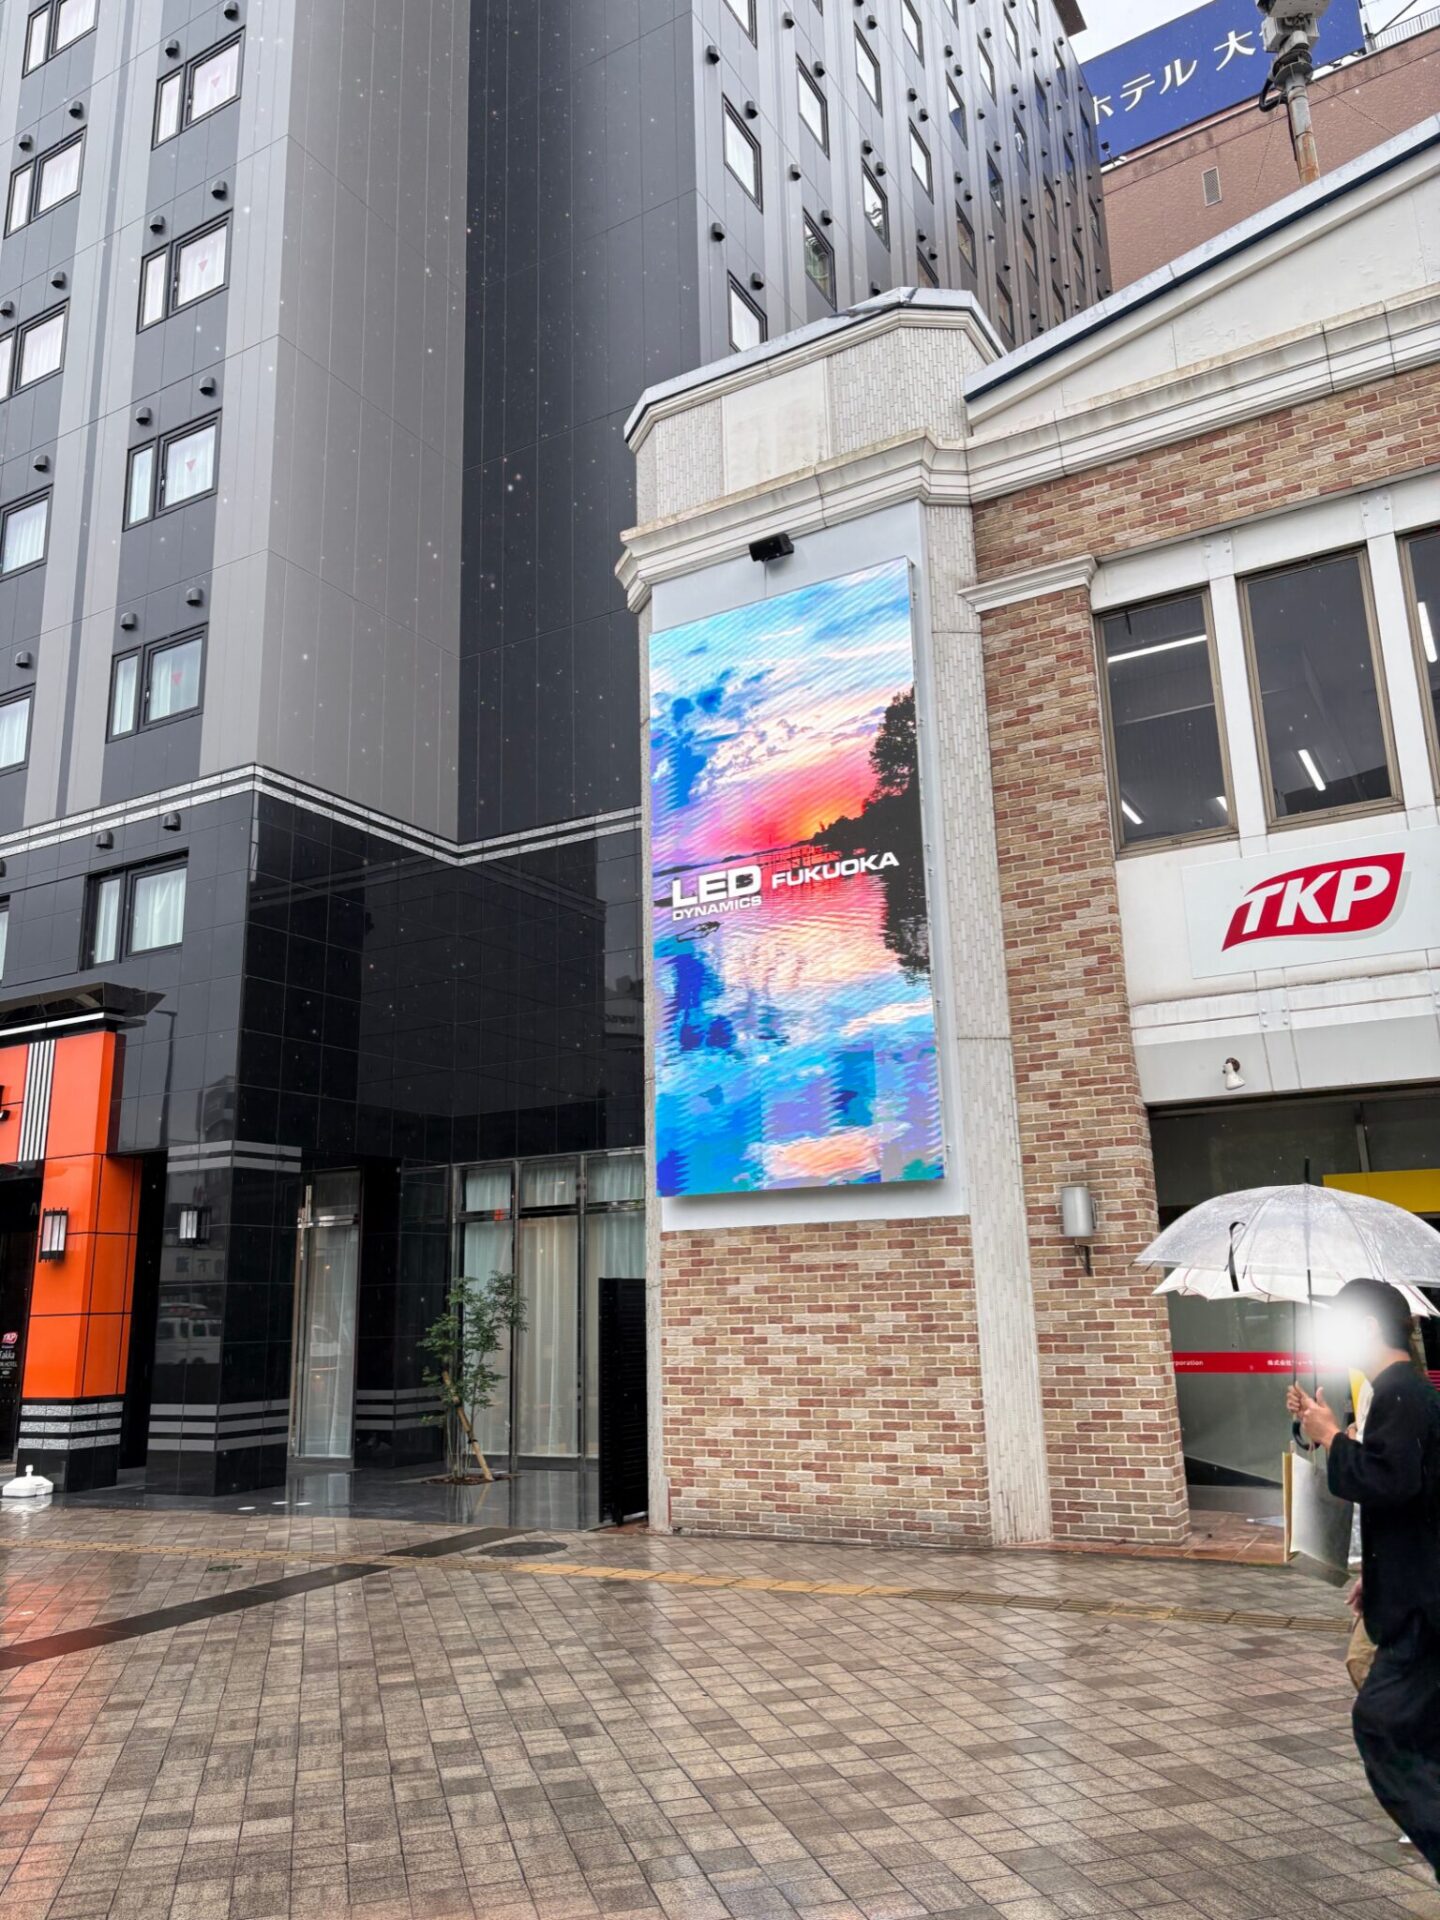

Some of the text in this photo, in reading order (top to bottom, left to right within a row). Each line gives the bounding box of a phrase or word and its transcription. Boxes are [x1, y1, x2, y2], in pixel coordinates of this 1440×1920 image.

[671, 851, 900, 908] LED FUKUOKA
[672, 895, 762, 921] DYNAMICS
[1238, 865, 1391, 935] TKP
